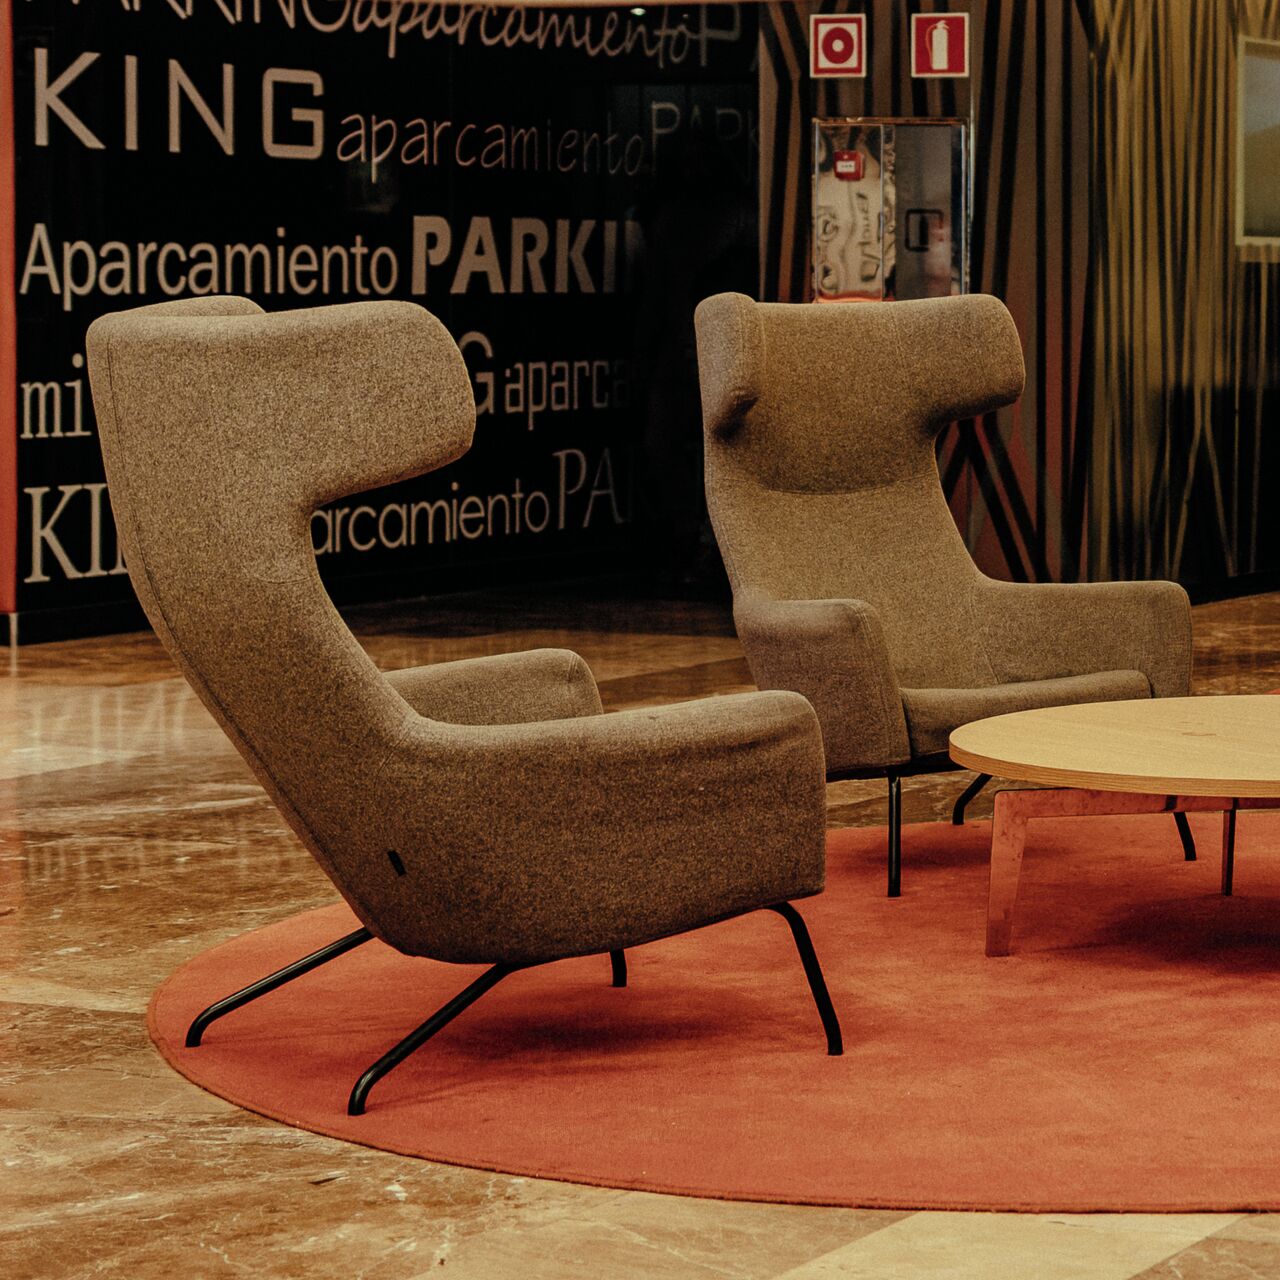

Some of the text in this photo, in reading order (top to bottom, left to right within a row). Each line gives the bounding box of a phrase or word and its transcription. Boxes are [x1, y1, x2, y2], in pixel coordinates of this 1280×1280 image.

[34, 47, 326, 160] KING
[337, 112, 645, 183] aparcamiento
[20, 222, 398, 311] Aparcamiento
